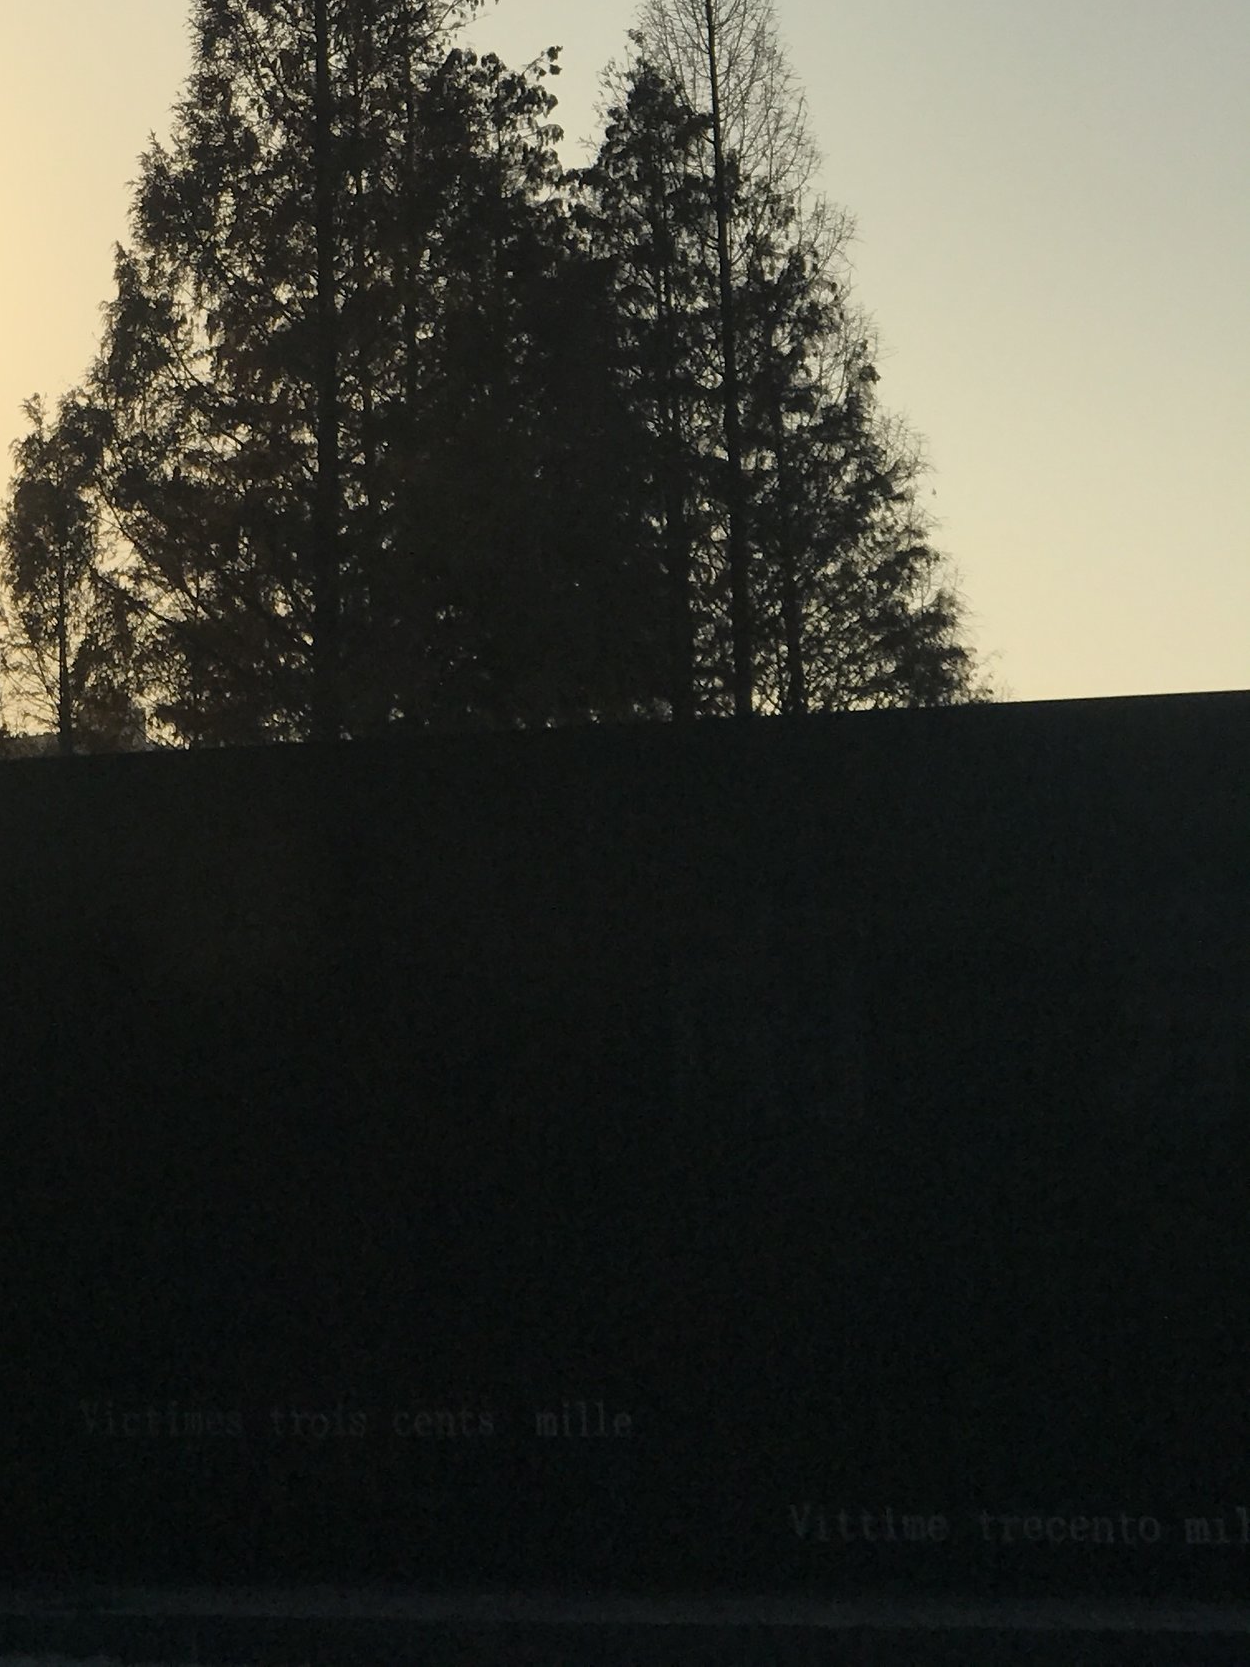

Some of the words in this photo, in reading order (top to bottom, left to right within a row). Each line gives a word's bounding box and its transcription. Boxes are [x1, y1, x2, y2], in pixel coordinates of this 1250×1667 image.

[80, 1399, 244, 1437] Victimes
[269, 1400, 368, 1438] trois
[392, 1405, 496, 1437] cents
[535, 1398, 634, 1438] mille
[789, 1502, 949, 1544] Vittime
[980, 1508, 1162, 1546] trecento
